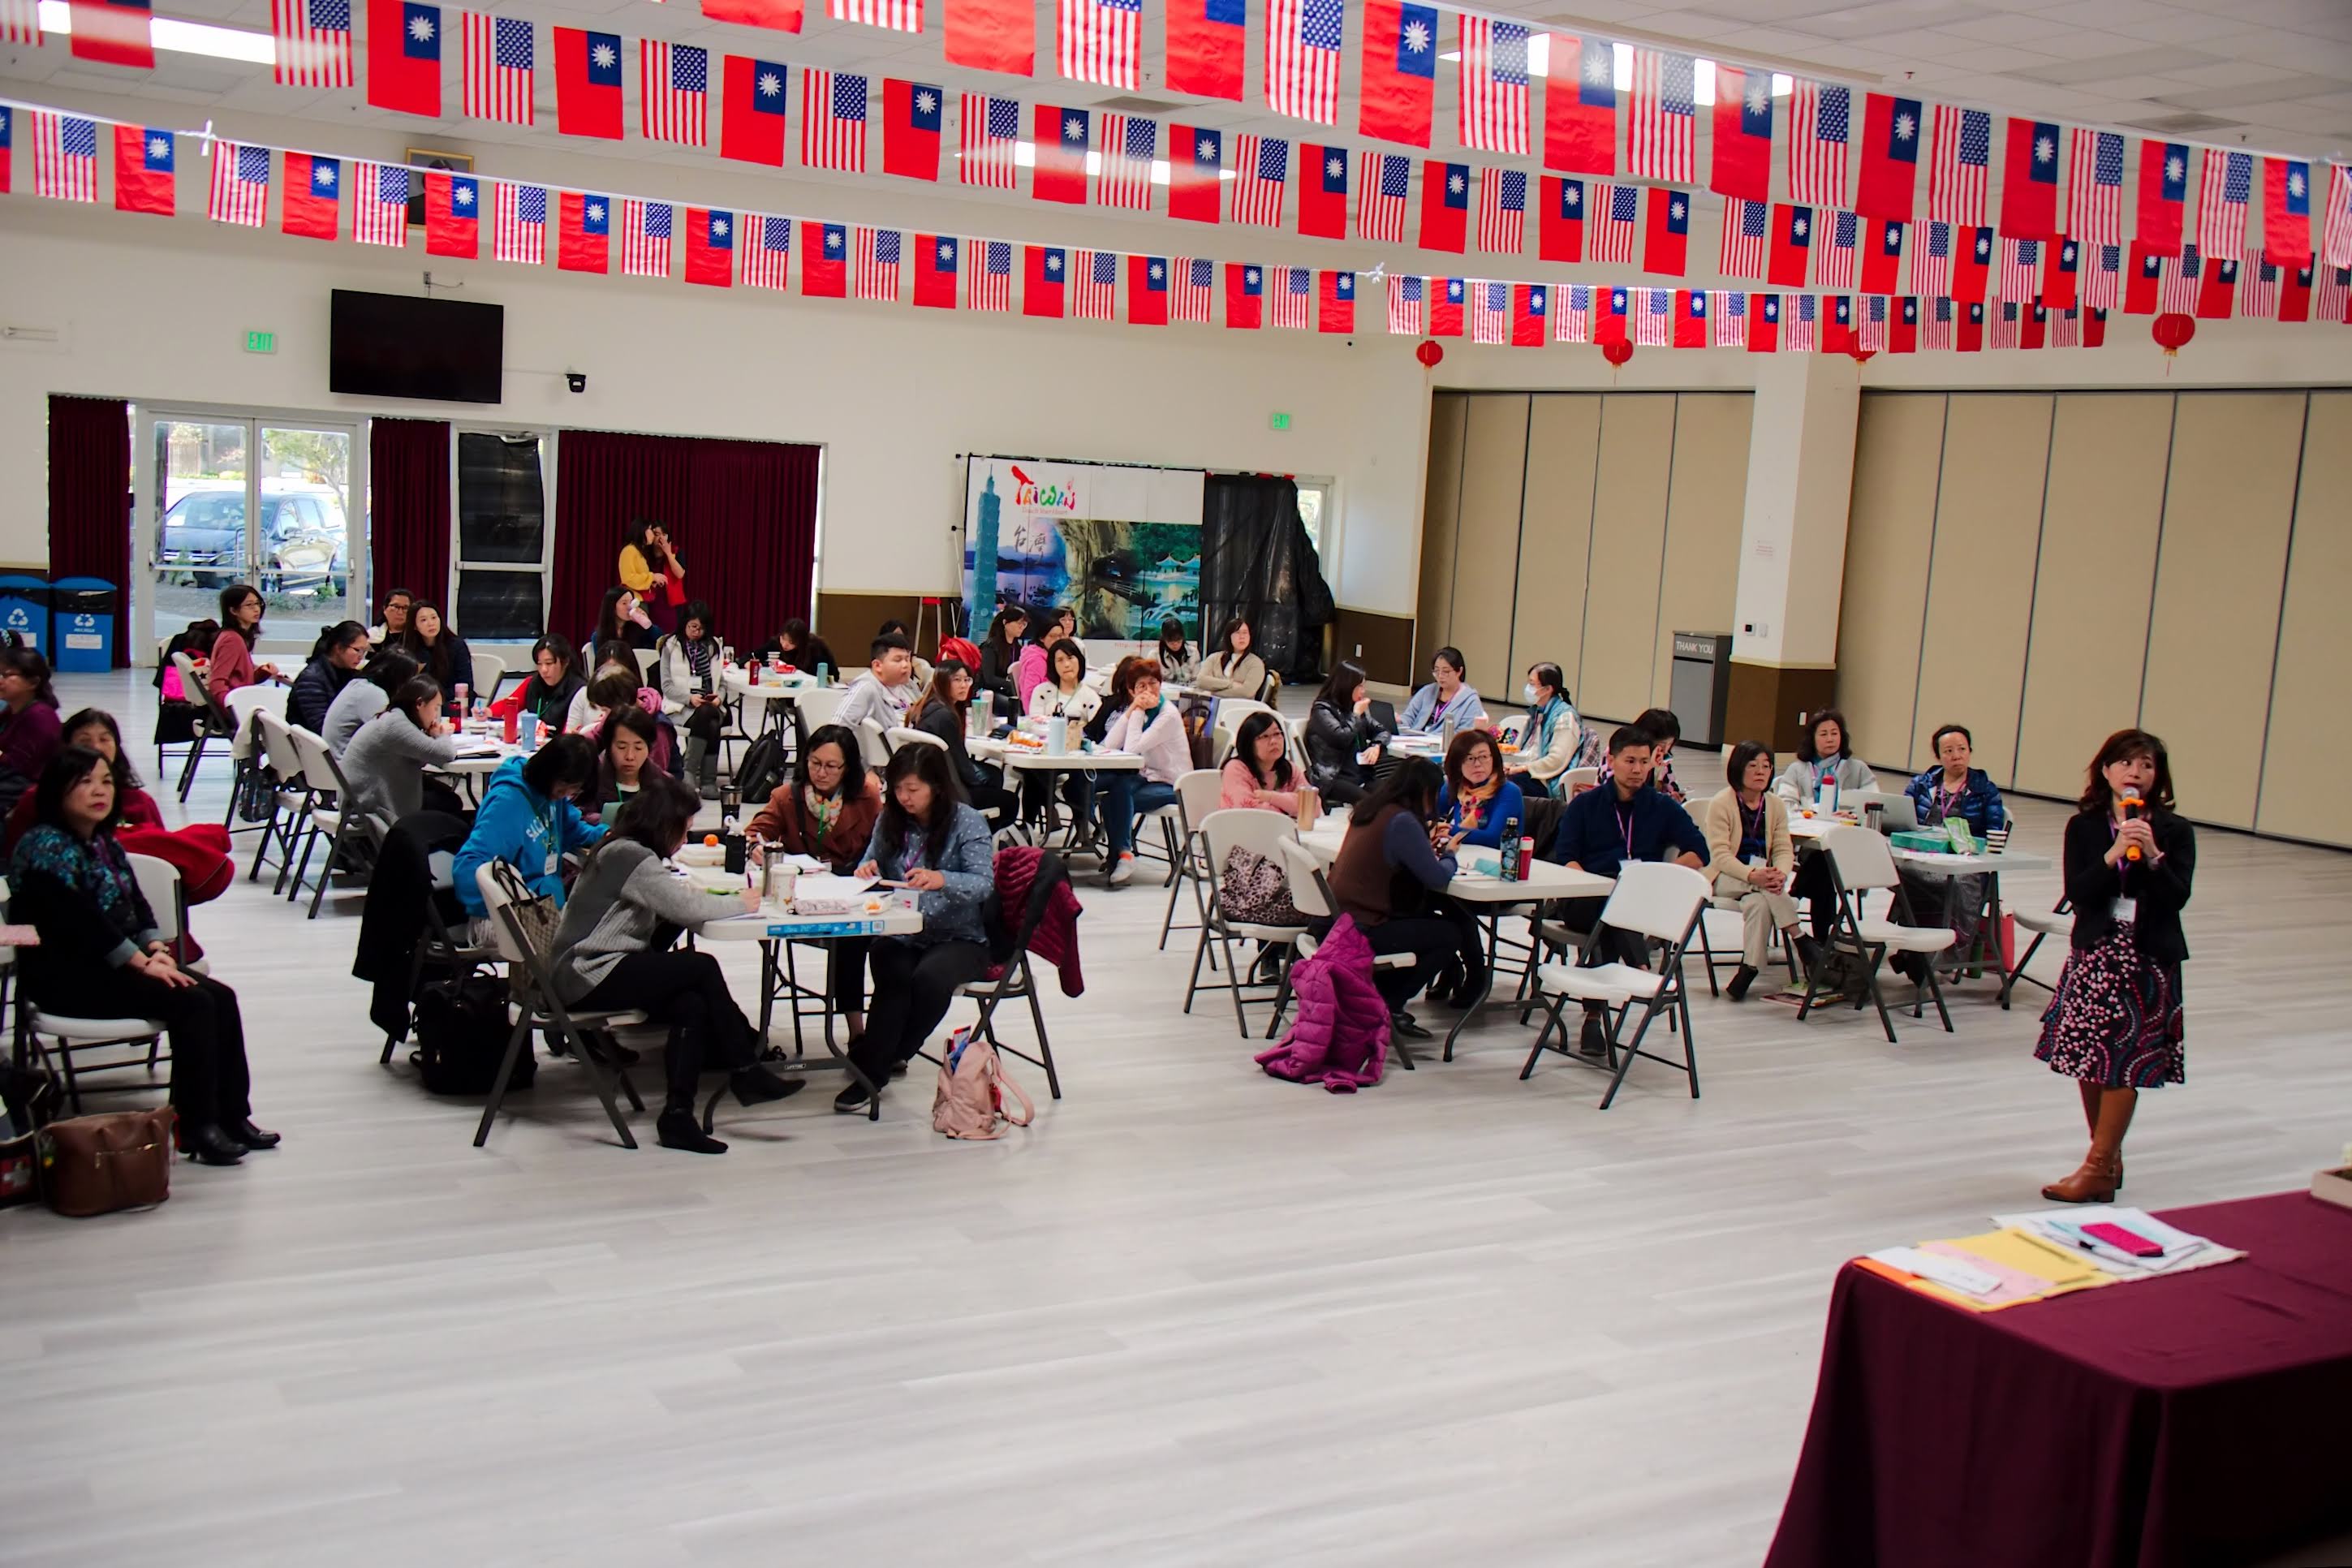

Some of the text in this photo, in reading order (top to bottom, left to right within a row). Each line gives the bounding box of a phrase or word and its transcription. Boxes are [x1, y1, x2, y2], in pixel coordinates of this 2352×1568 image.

[248, 331, 273, 351] EXIT
[1676, 641, 1714, 654] THANK YOU
